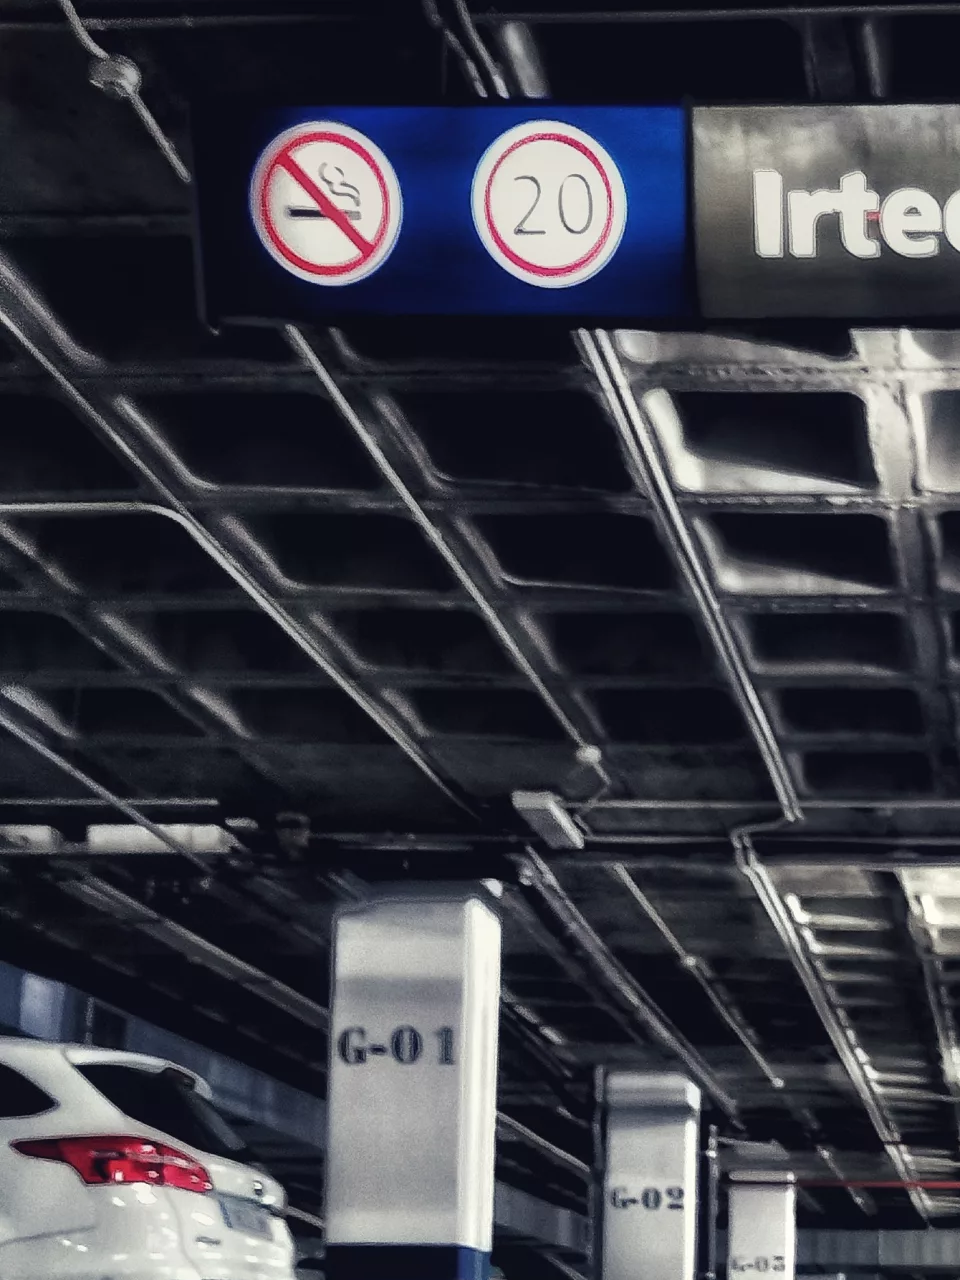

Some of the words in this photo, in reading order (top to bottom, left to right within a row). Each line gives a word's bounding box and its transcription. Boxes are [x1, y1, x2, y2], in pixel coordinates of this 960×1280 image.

[513, 172, 594, 236] 20
[337, 1025, 456, 1066] G-01
[610, 1186, 685, 1210] G-02
